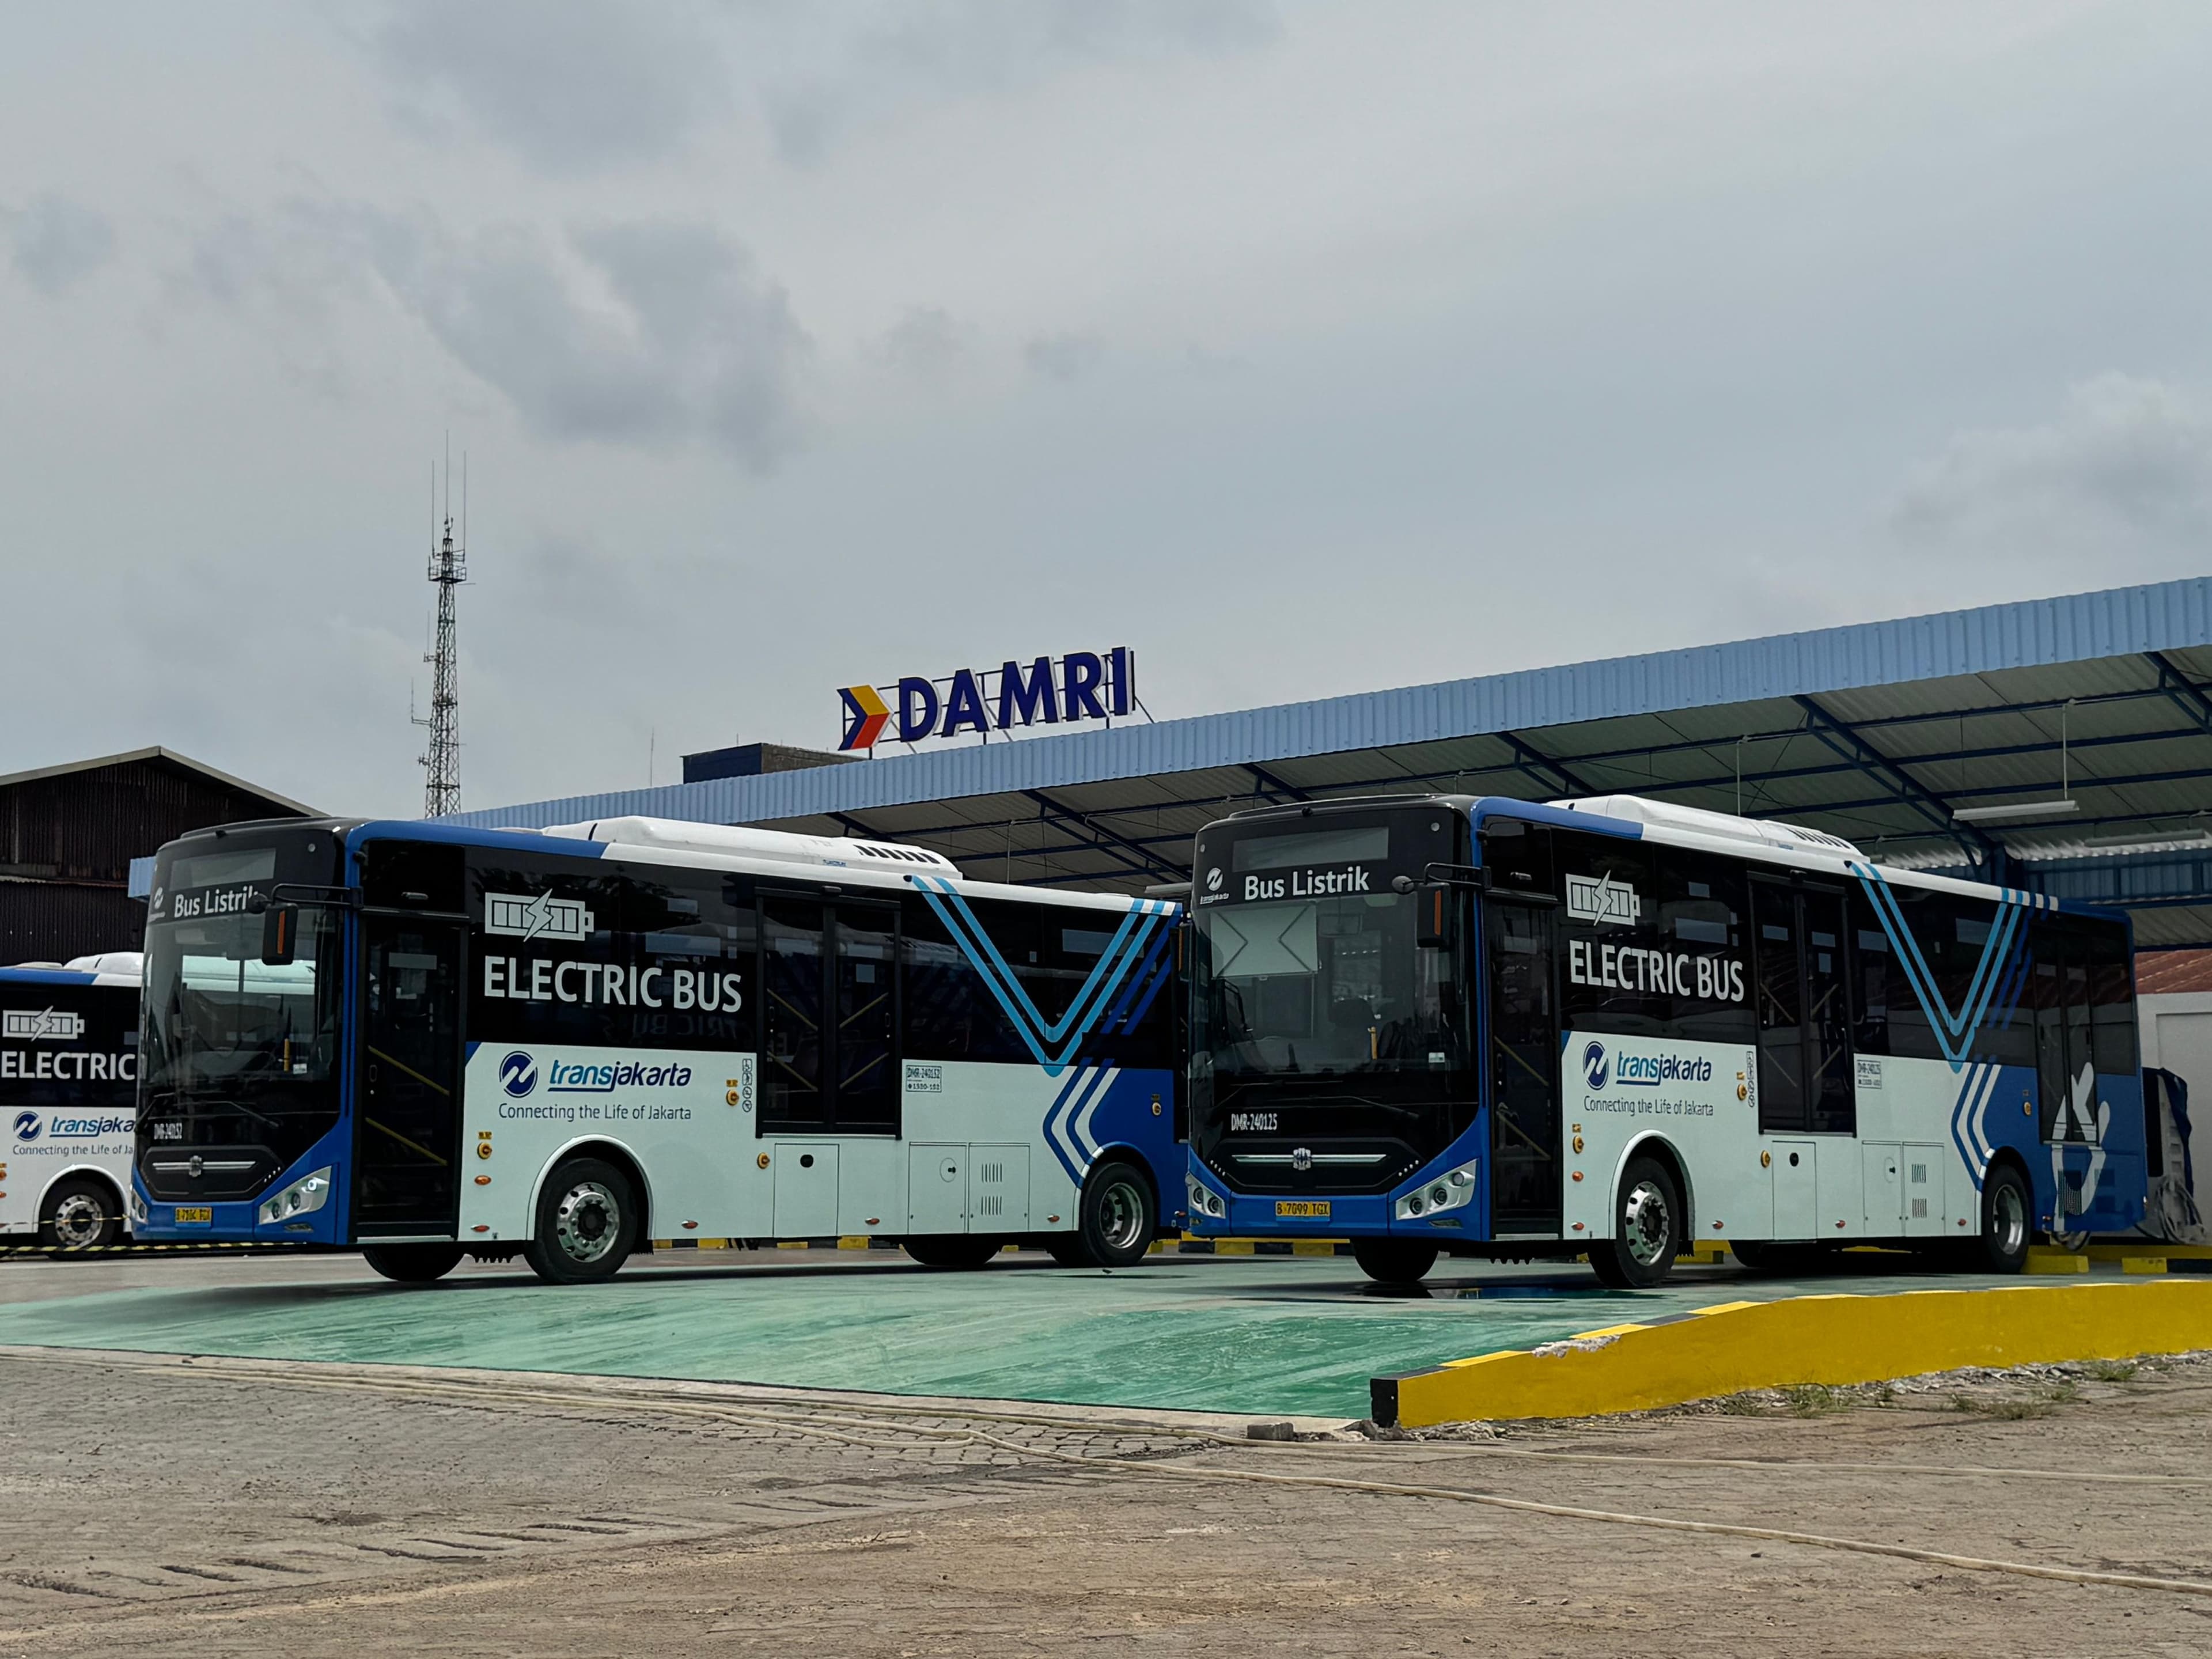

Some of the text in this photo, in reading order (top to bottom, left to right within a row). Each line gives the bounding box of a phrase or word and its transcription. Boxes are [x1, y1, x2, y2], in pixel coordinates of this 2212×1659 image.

[899, 646, 1134, 743] DAMRI
[1245, 866, 1370, 901] Bus Listrik
[175, 893, 200, 918] Bus
[484, 955, 742, 1013] ELECTRIC BUS
[1569, 940, 1744, 1002] ELECTRIC BUS
[1, 1051, 136, 1081] ELECTRIC
[548, 1059, 692, 1092] transjakarta
[1616, 1051, 1712, 1086] transjakarta
[499, 1103, 691, 1122] Connecting the Life of Jakarta
[1584, 1096, 1714, 1116] Connecting the Life of Jakarta
[50, 1116, 135, 1138] transjaka
[1231, 1113, 1278, 1131] DMR-240125
[13, 1145, 70, 1157] Connecting
[73, 1145, 88, 1155] the
[92, 1145, 110, 1155] Life
[112, 1145, 122, 1155] of
[1277, 1202, 1282, 1215] B
